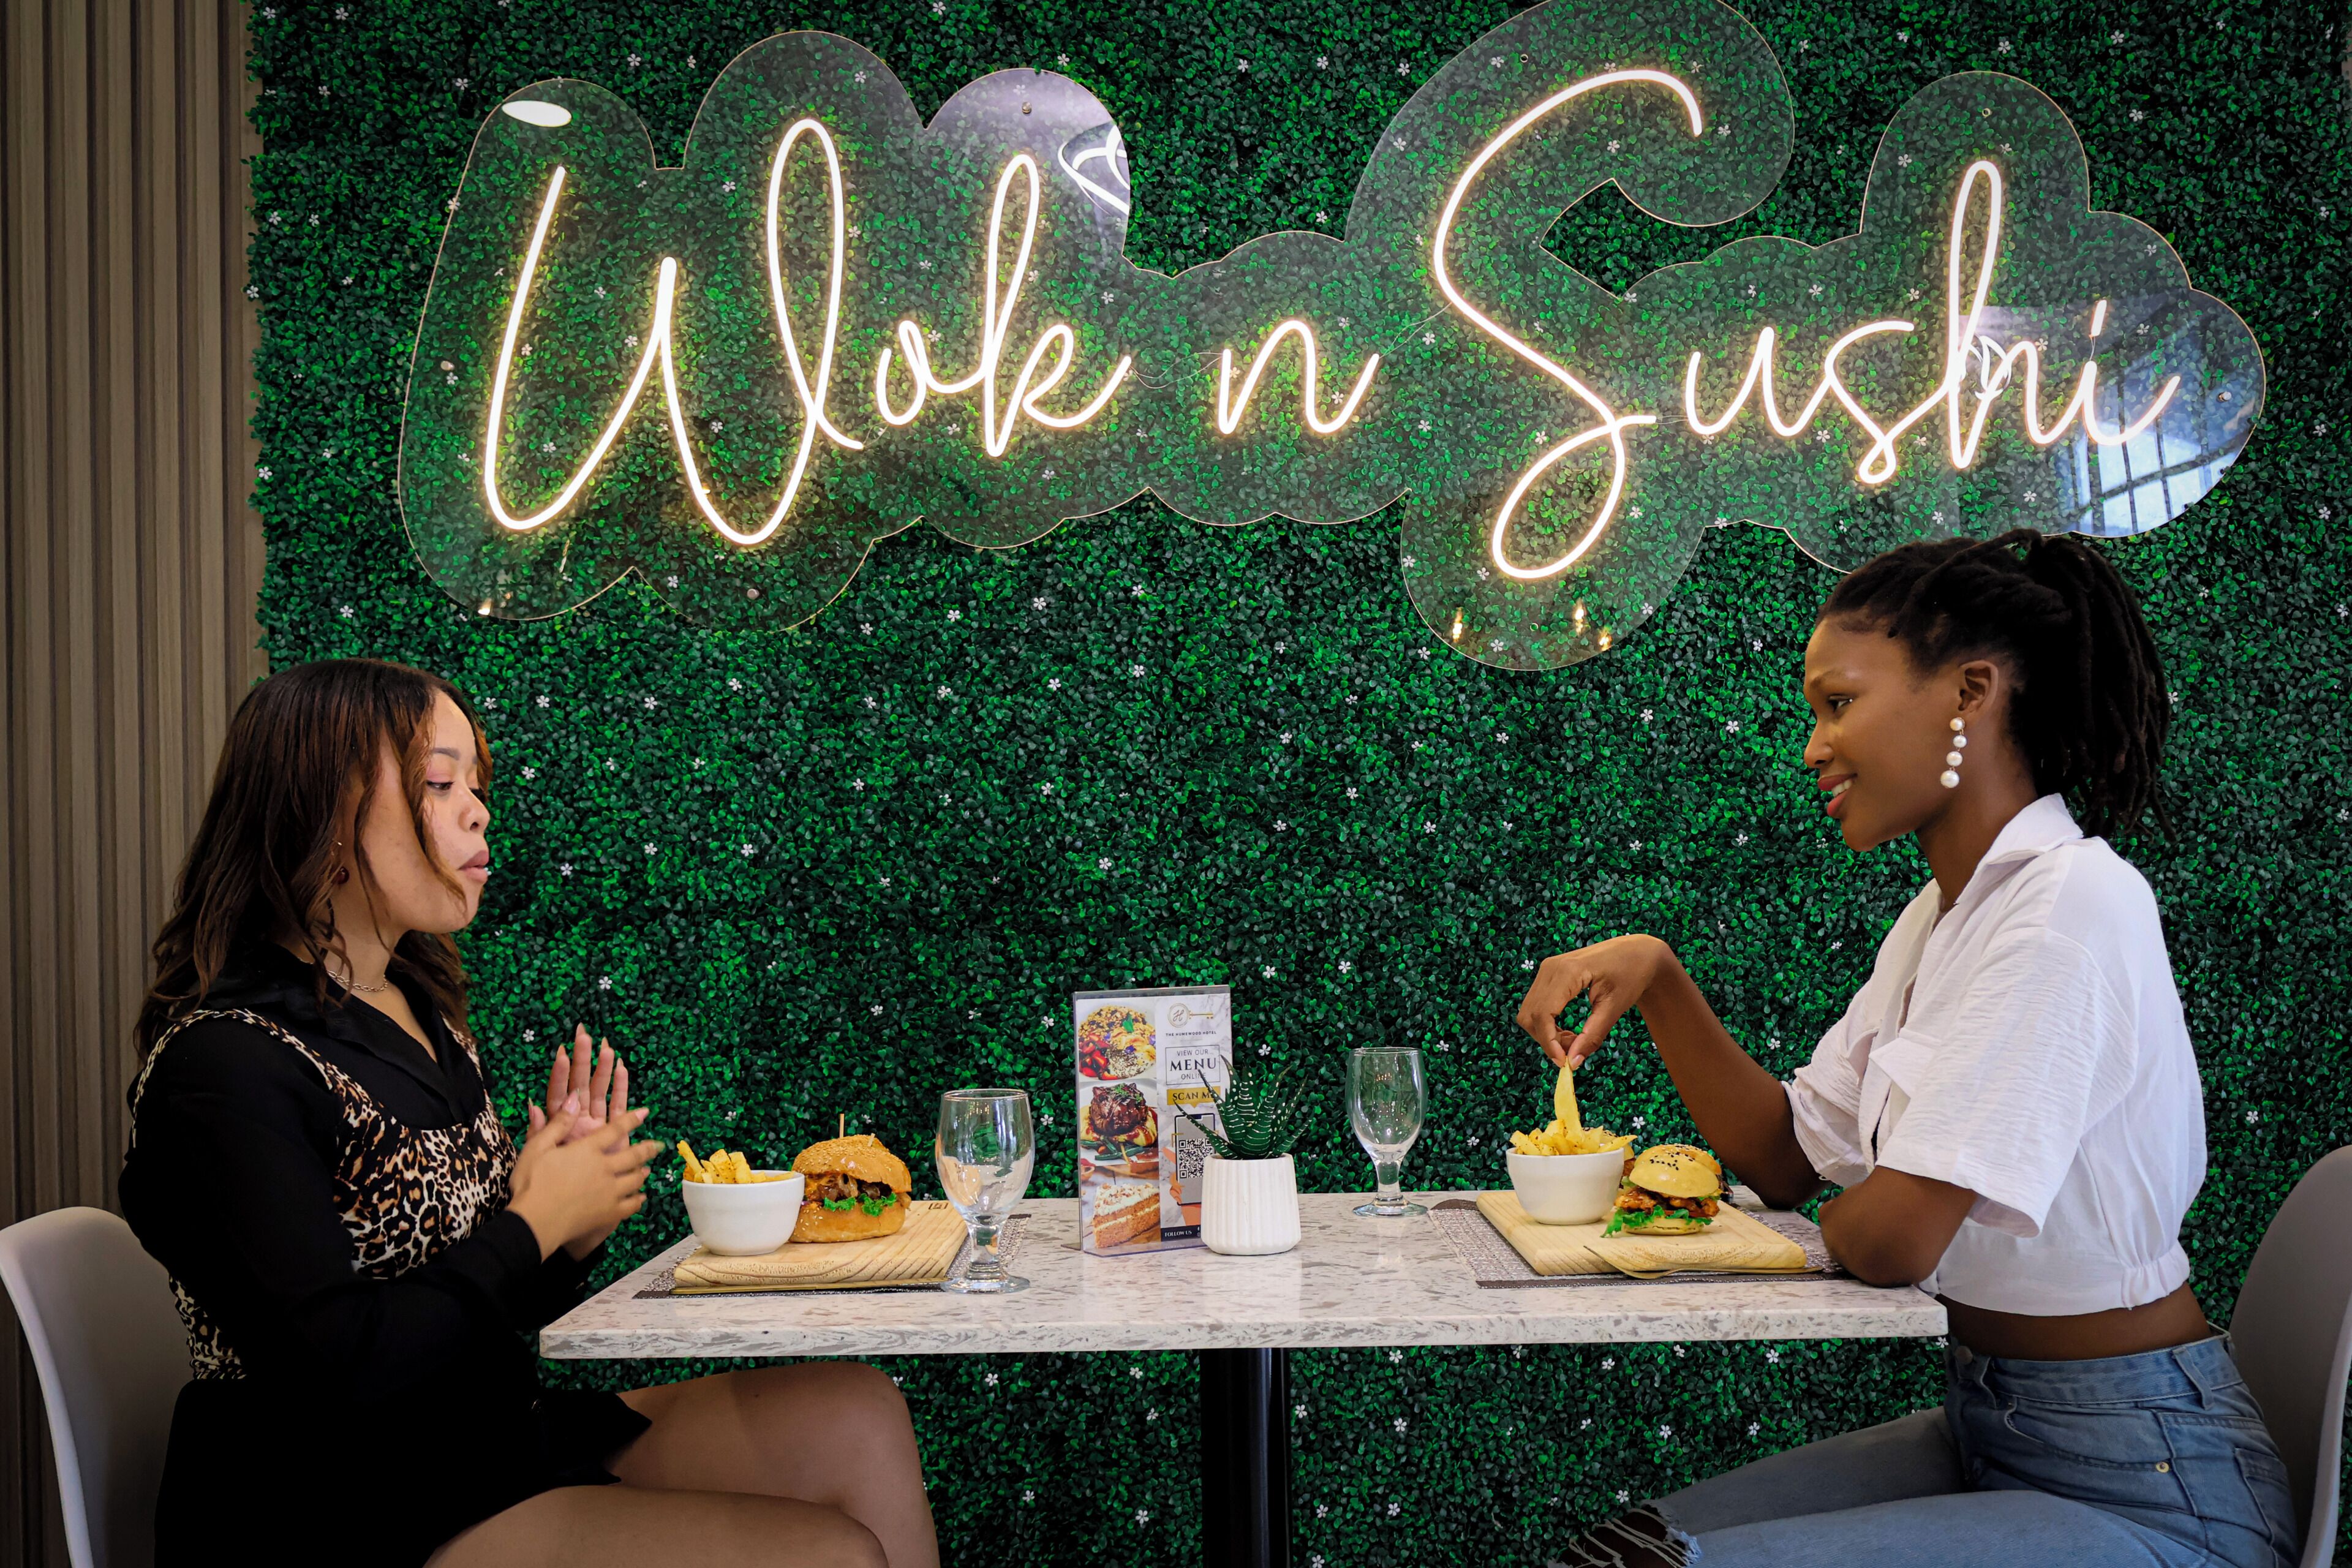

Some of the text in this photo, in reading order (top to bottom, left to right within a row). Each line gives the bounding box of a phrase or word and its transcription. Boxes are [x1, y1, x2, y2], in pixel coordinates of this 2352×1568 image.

[481, 66, 2182, 582] Wok n Sushi
[1170, 1058, 1216, 1071] MENU
[1172, 1091, 1199, 1101] SCAN
